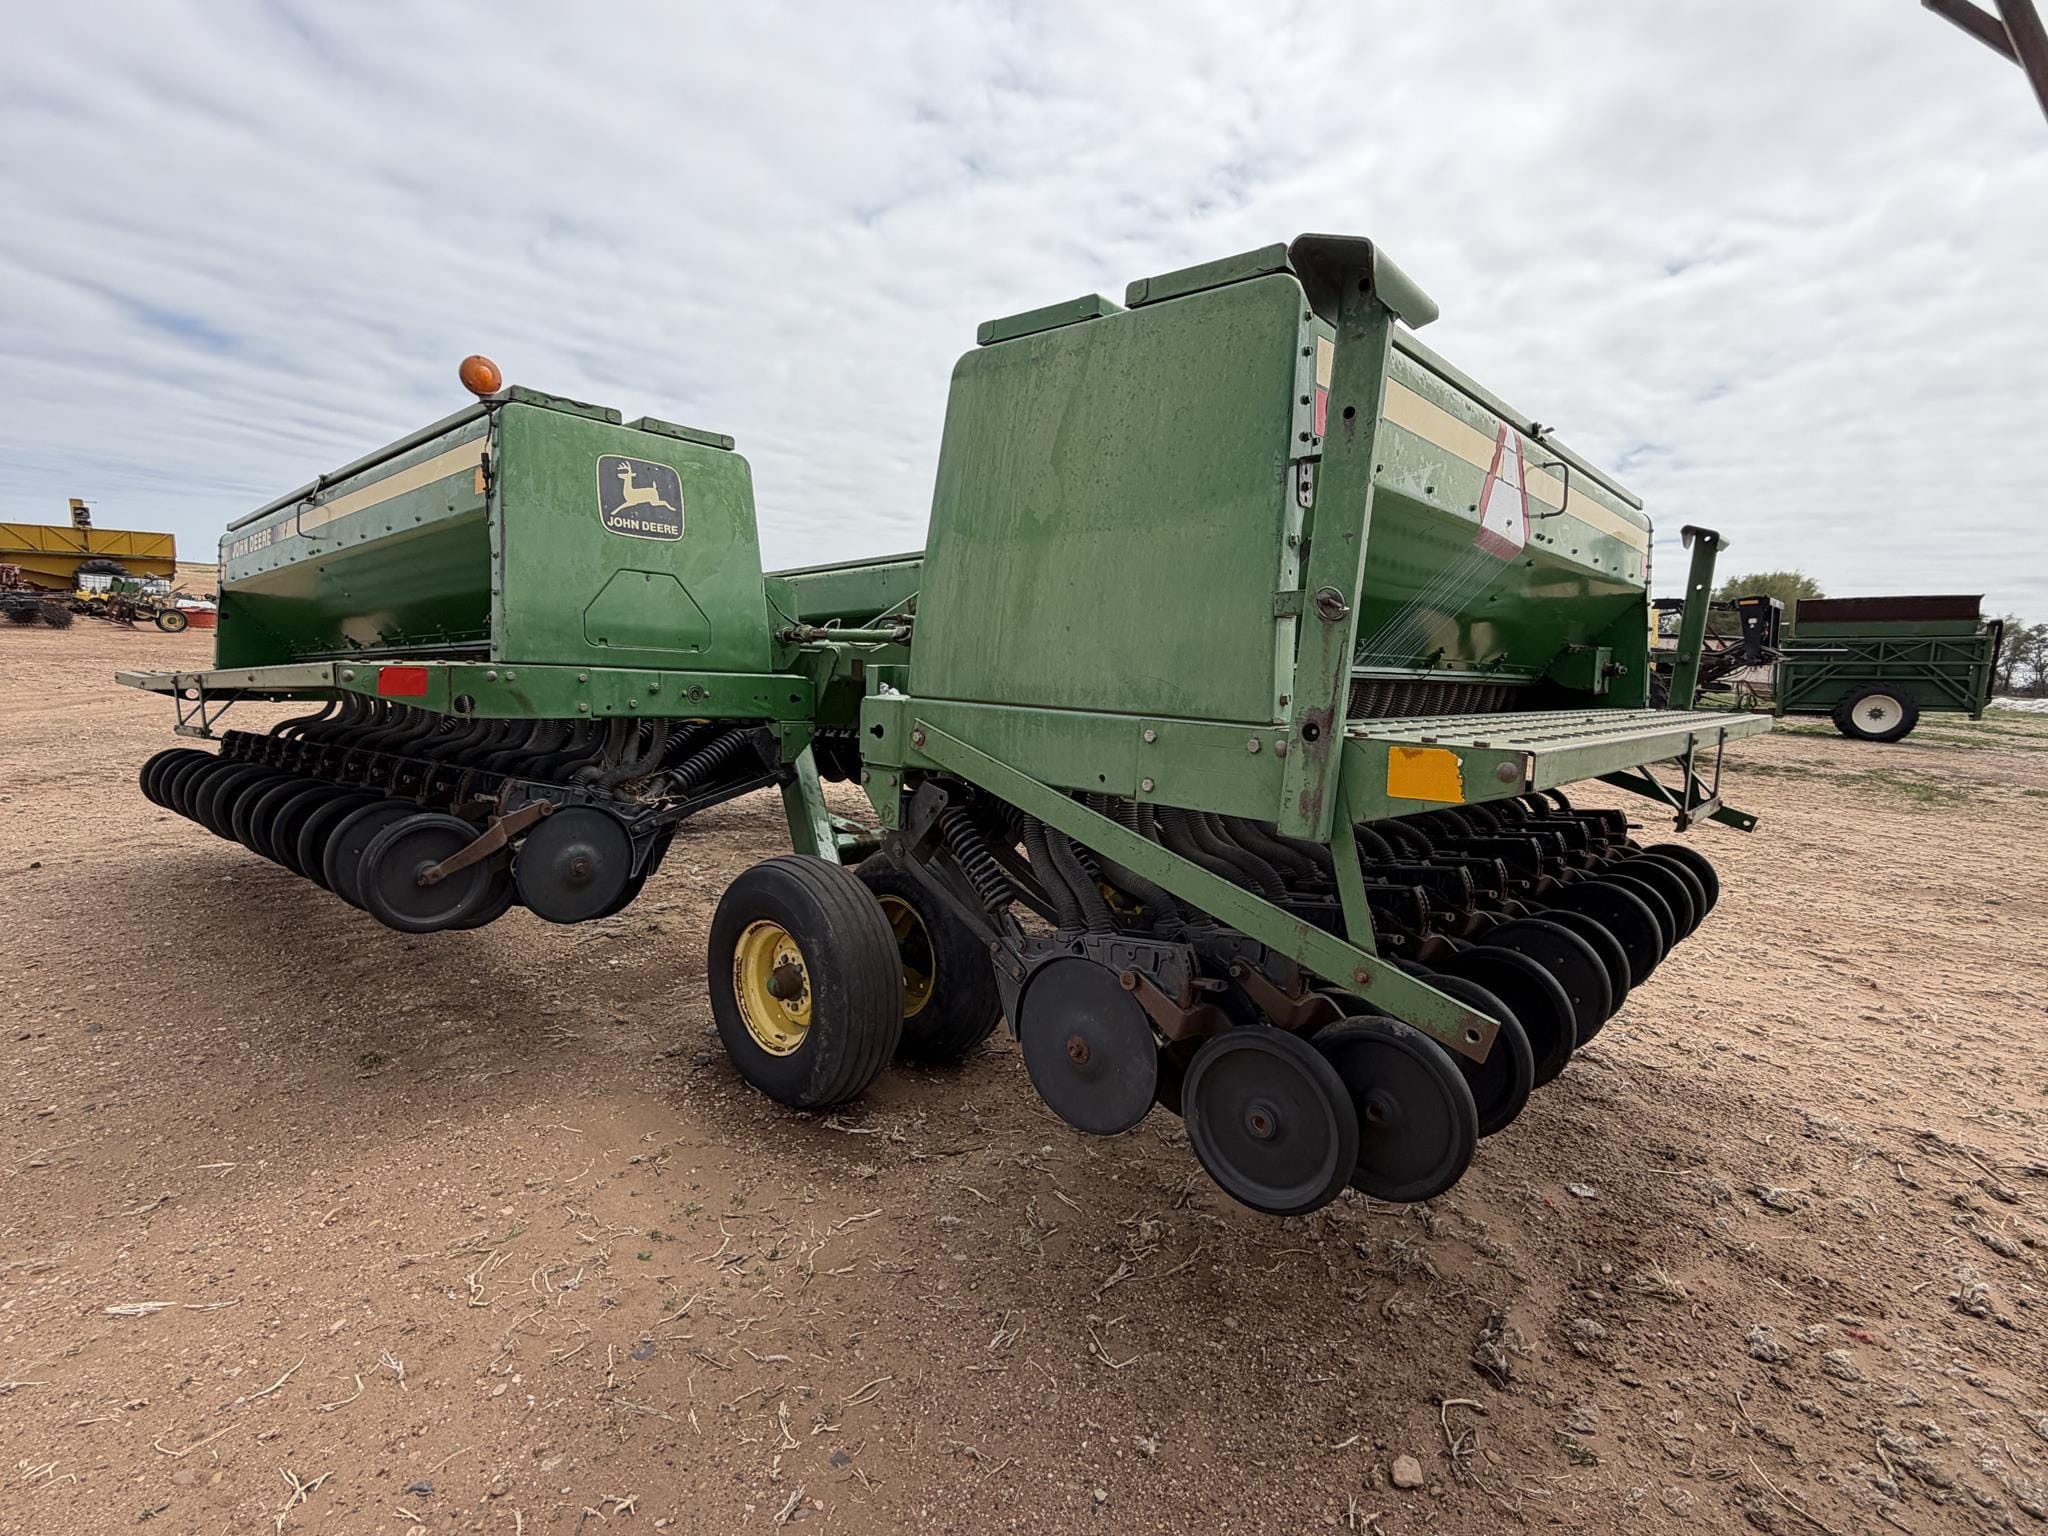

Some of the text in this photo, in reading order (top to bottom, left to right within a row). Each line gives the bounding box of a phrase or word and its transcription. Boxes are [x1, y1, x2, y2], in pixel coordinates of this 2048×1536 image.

[607, 516, 679, 535] JOHN DEERE
[232, 527, 272, 559] JOHN DEERE
